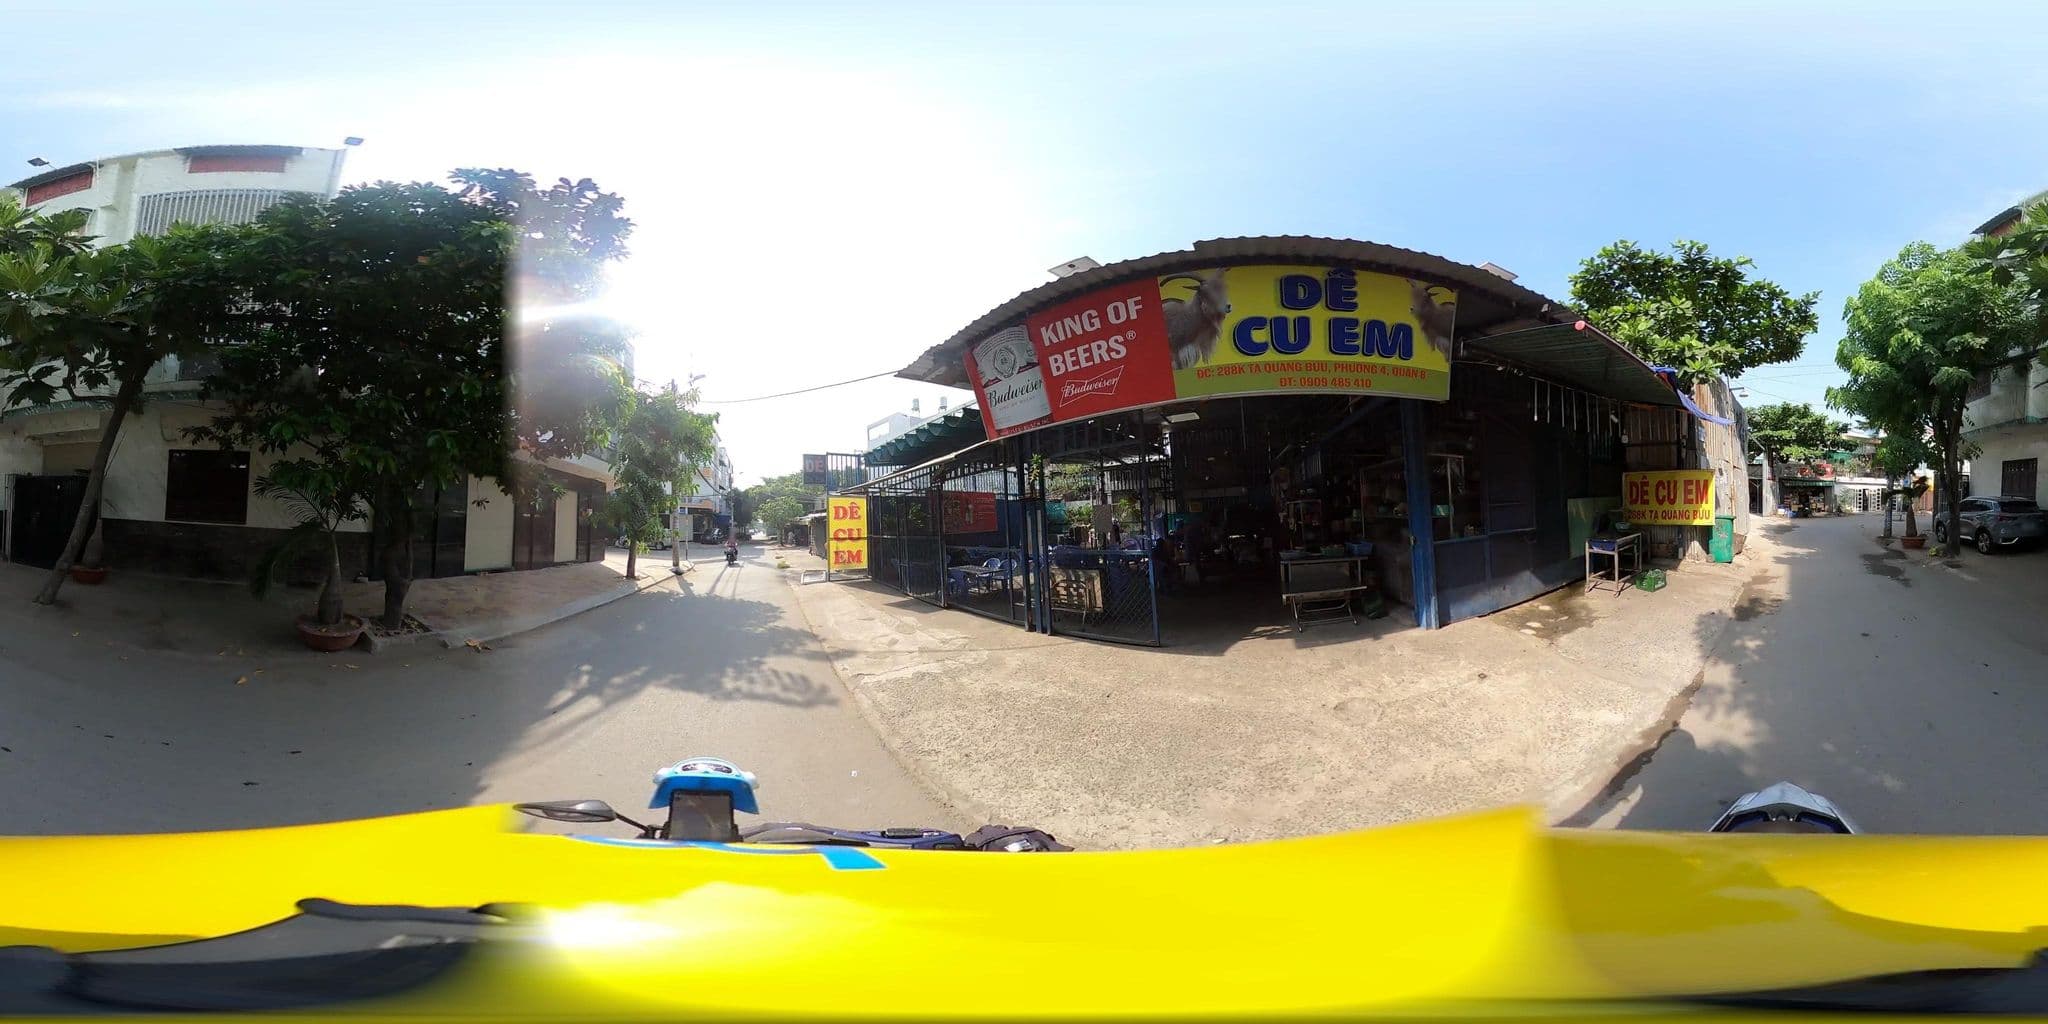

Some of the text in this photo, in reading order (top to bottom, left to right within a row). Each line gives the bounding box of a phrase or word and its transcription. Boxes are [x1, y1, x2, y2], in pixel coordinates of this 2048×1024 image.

[1279, 267, 1360, 312] DÊ
[1040, 296, 1143, 347] KING OF
[1232, 316, 1414, 360] CU EM
[1264, 362, 1302, 373] QUANG
[987, 376, 1043, 409] Budweiser
[1064, 376, 1118, 398] Budweiser
[1299, 377, 1328, 387] 0909
[1331, 377, 1351, 387] 485
[1354, 378, 1372, 388] 410
[1628, 475, 1709, 505] DÊ CU EM
[833, 501, 862, 520] DÊ
[1661, 510, 1690, 521] QUANG
[833, 528, 862, 543] CU
[833, 550, 863, 565] EM
